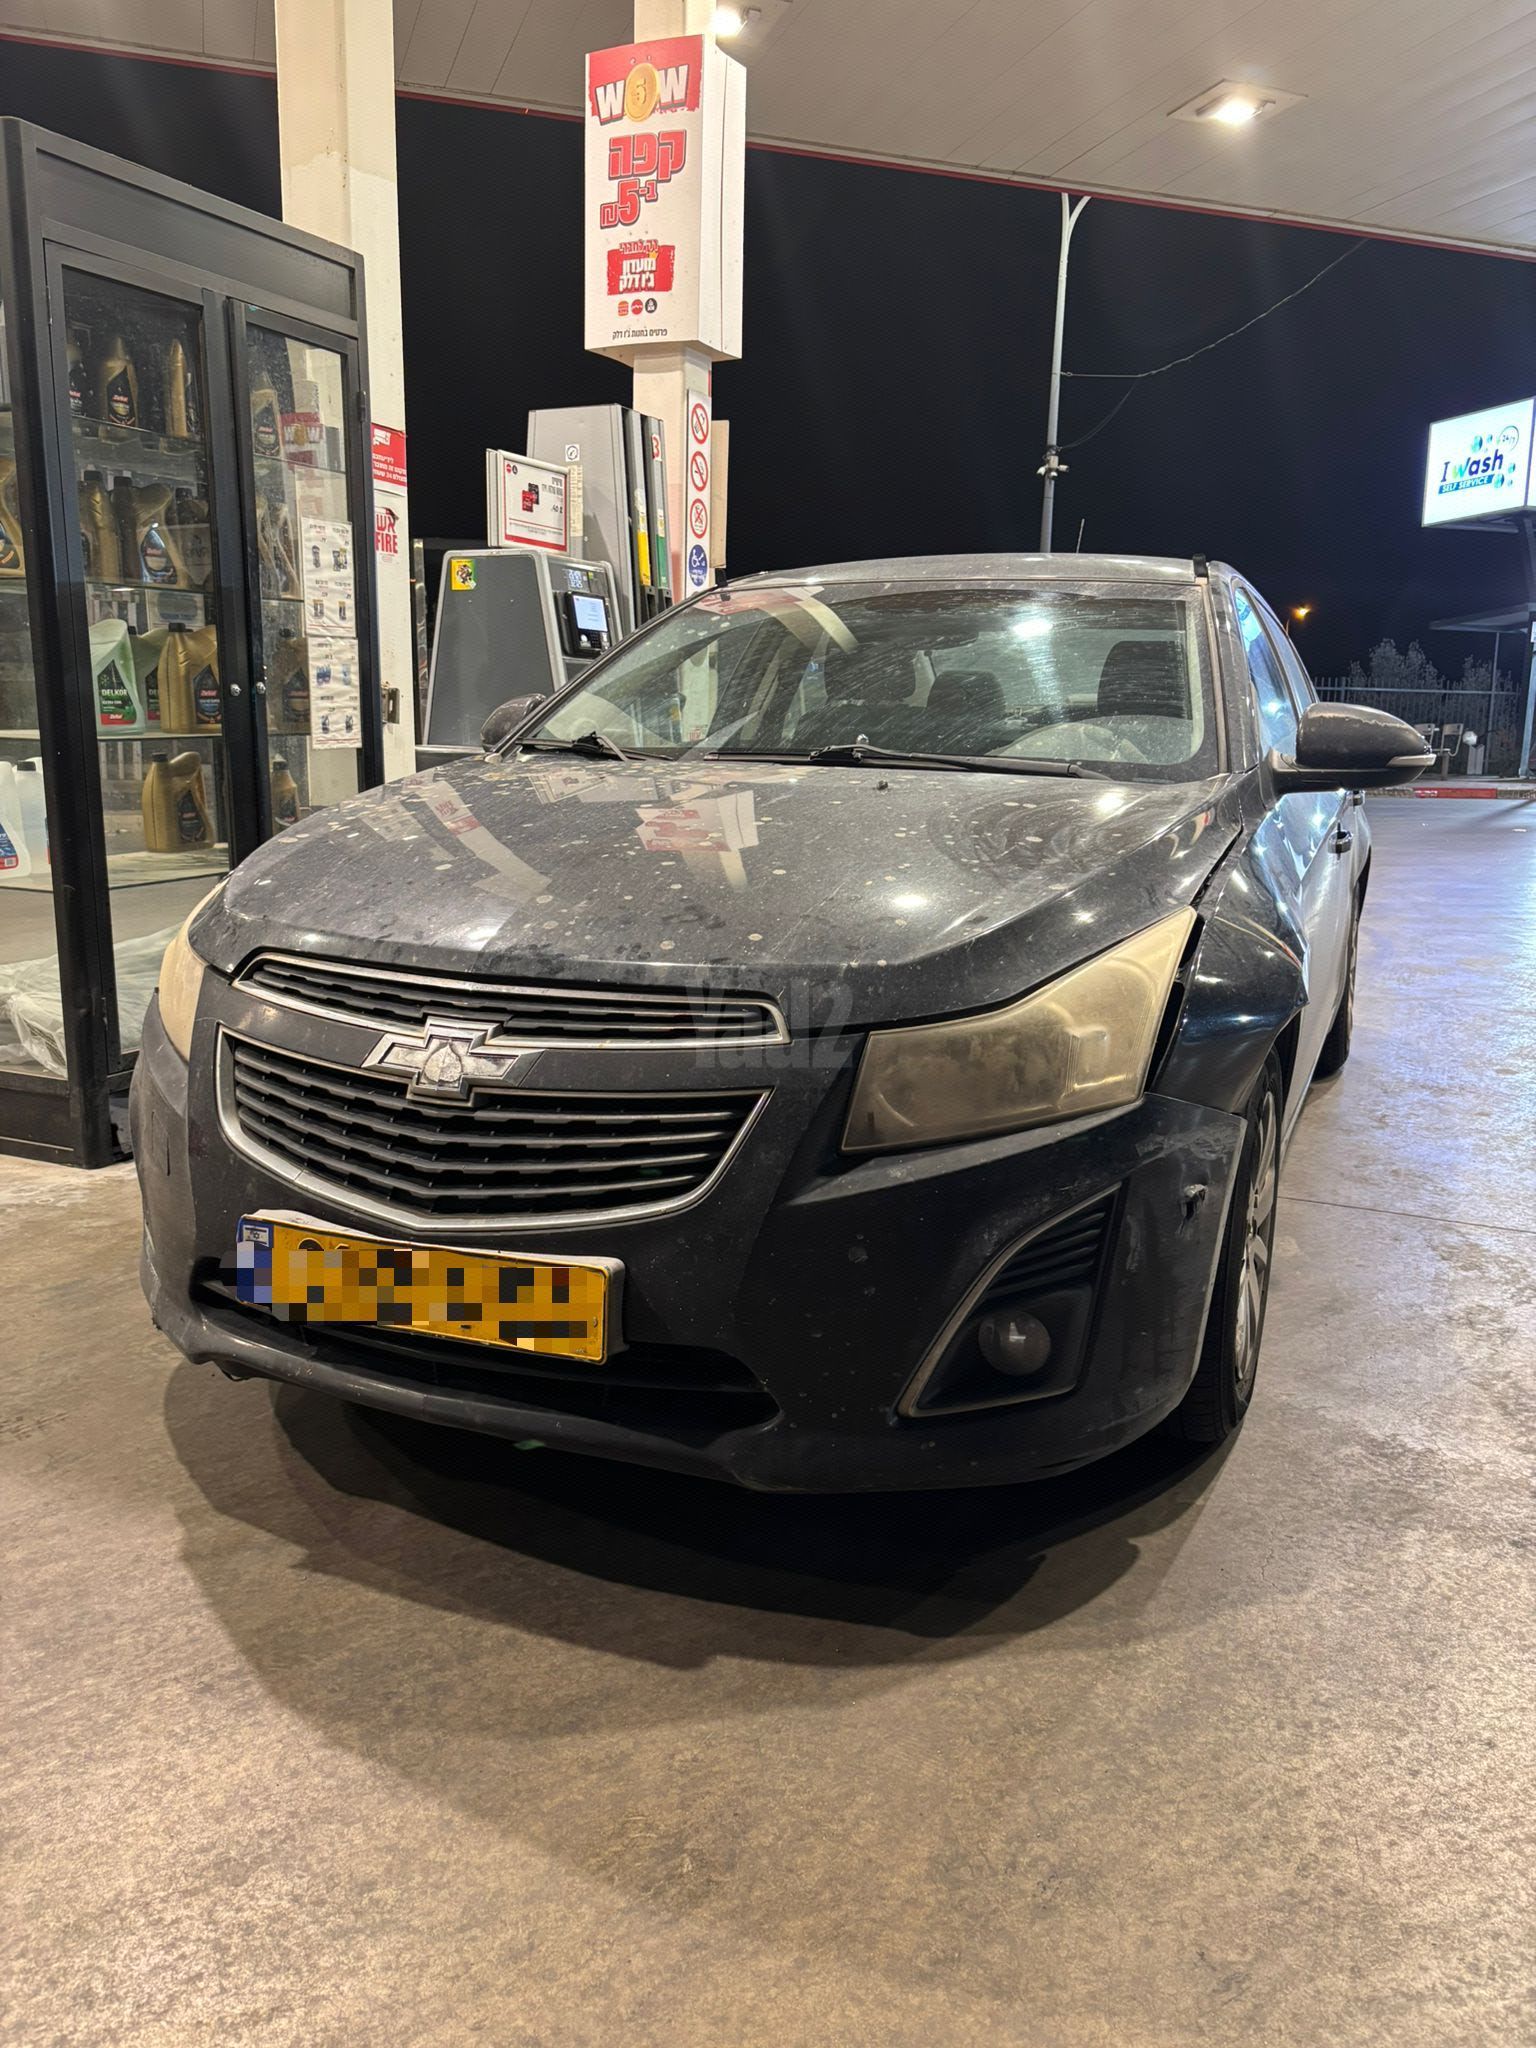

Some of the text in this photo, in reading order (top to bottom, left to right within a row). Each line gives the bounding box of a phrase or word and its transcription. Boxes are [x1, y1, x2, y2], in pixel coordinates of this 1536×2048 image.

[608, 129, 687, 181] קפה
[622, 257, 657, 275] מועדון
[619, 274, 641, 292] דלק
[652, 435, 661, 460] 3
[376, 513, 396, 533] אש
[375, 532, 398, 554] FIRE
